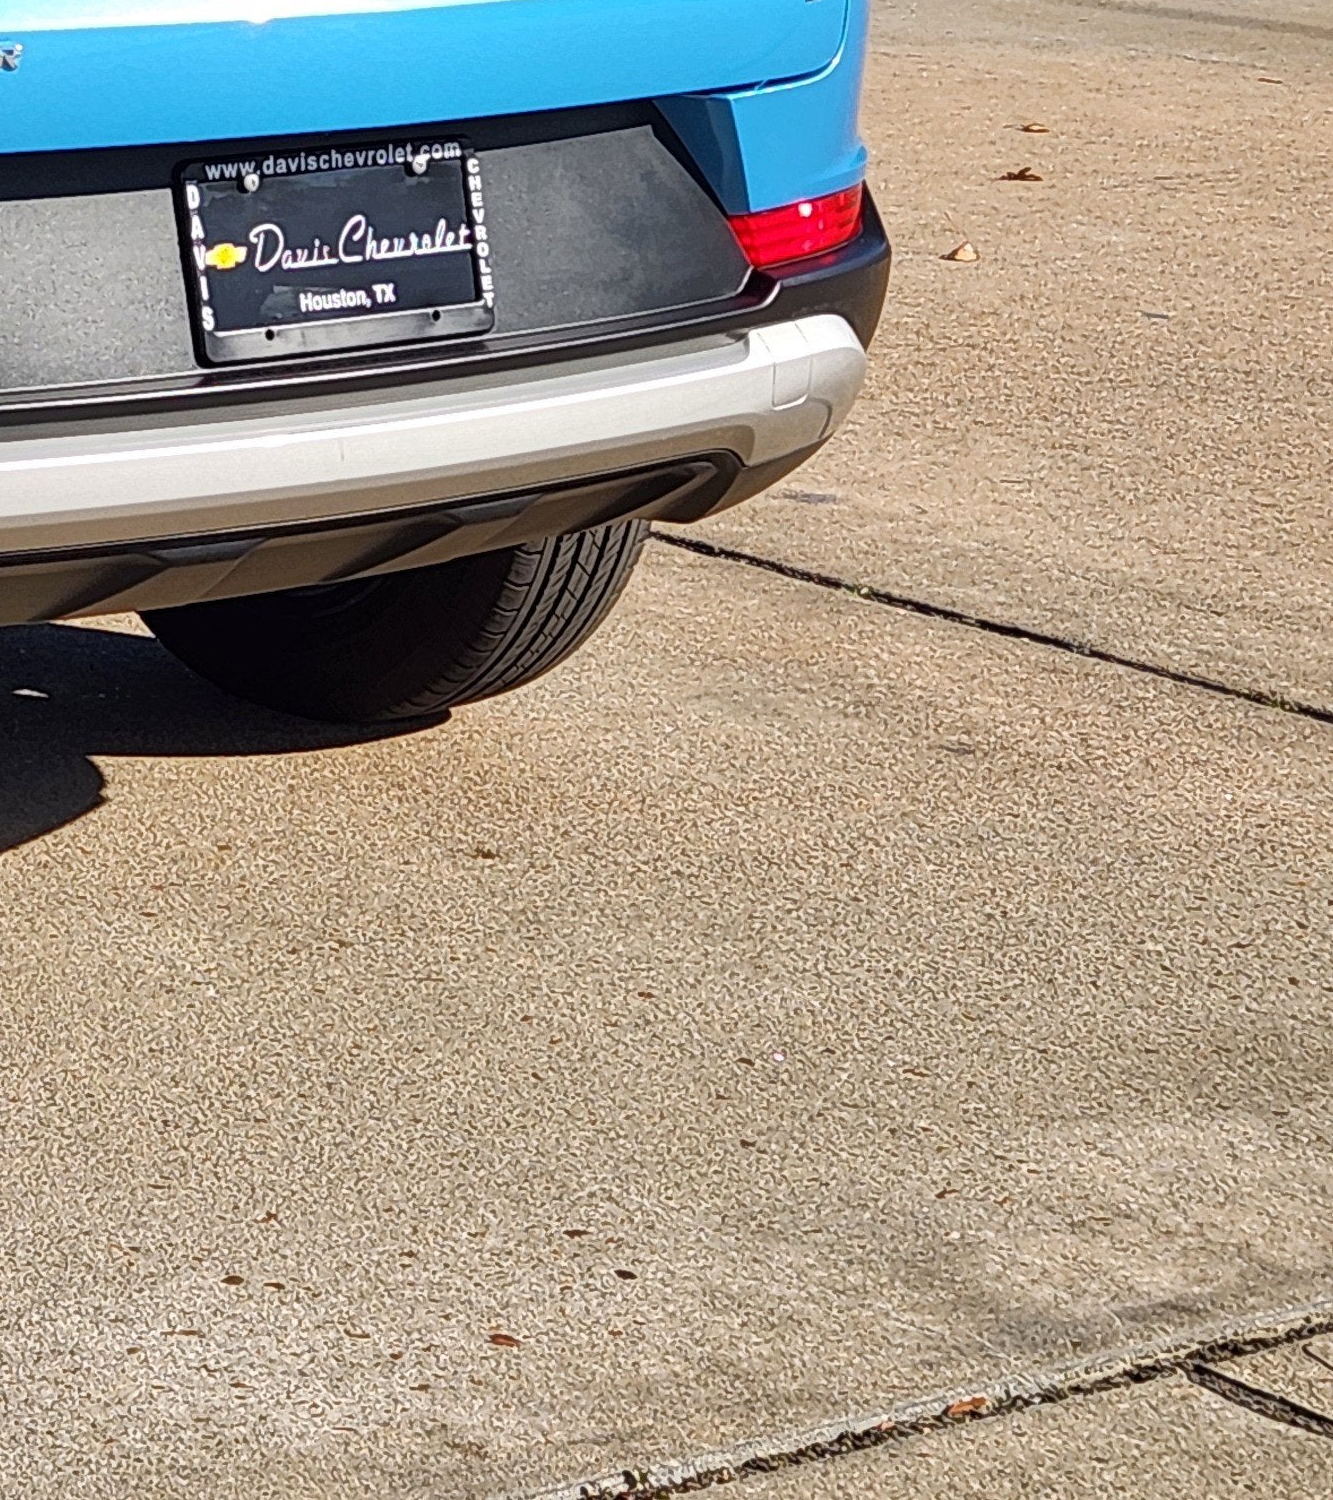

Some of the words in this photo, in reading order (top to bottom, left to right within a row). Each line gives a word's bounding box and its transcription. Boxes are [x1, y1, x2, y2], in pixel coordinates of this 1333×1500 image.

[185, 183, 216, 332] DAVIS
[248, 222, 340, 273] Davis
[338, 214, 474, 264] Chevrolet
[466, 157, 495, 309] CHEVROLET
[299, 288, 372, 313] Houston,
[371, 282, 397, 304] TX
